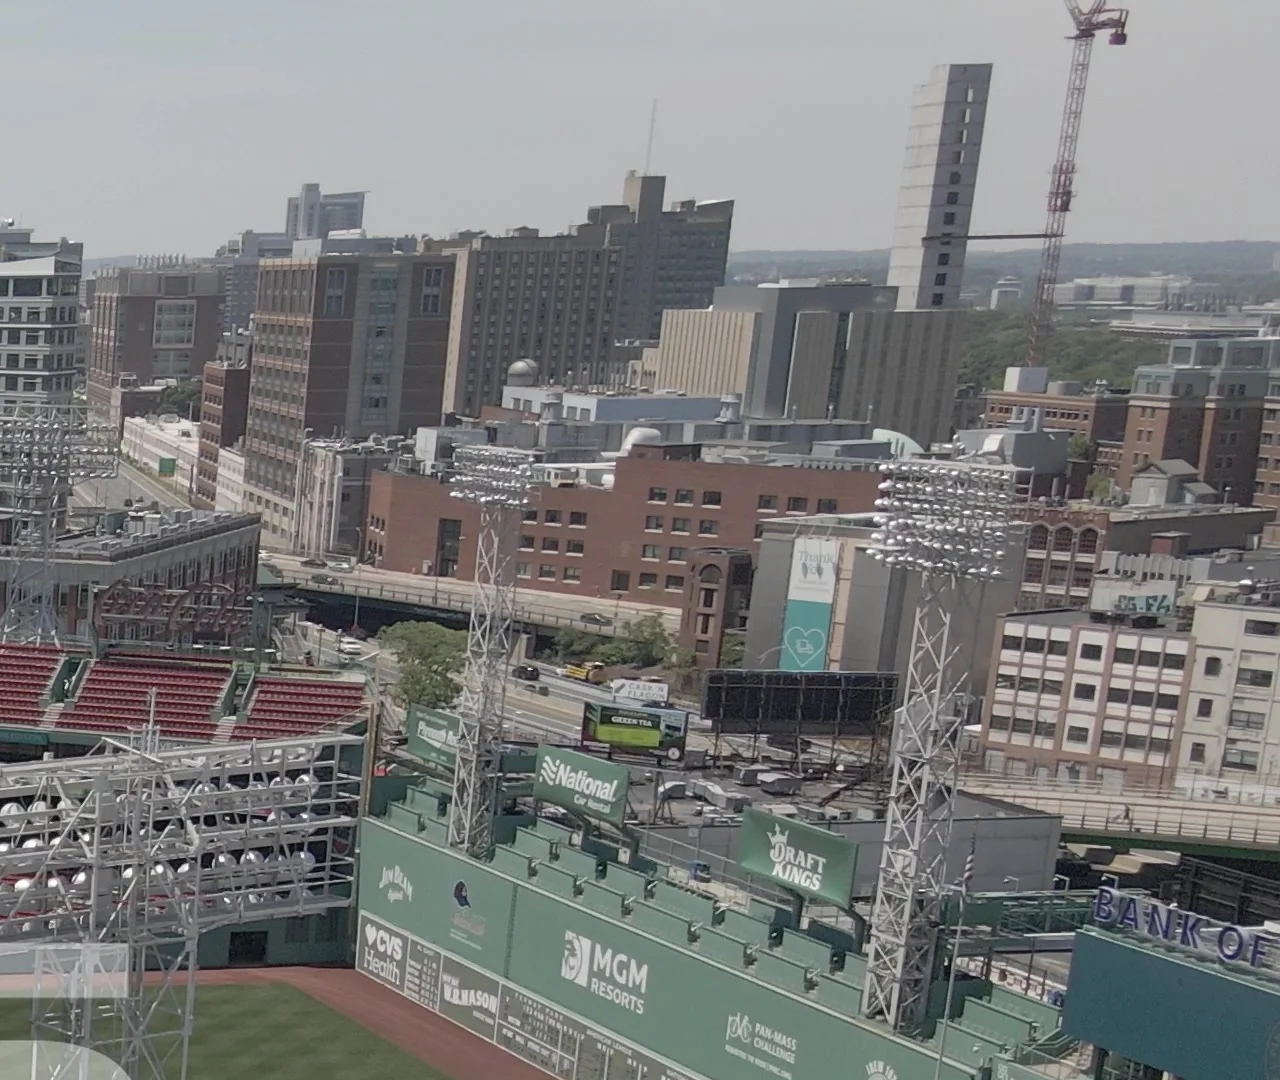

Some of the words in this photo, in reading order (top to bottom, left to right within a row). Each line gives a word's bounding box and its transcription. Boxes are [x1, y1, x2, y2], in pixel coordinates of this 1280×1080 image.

[555, 764, 618, 801] National
[769, 842, 826, 873] DRAFT
[772, 863, 822, 891] KINGS
[1094, 886, 1206, 950] BANK
[1217, 924, 1271, 968] OF
[377, 930, 403, 961] CVS
[363, 947, 400, 985] Health
[593, 943, 648, 994] MGM
[591, 977, 644, 1015] RESORTS
[753, 1037, 796, 1065] CHALLENGE
[755, 1023, 797, 1051] PAN-MASS
